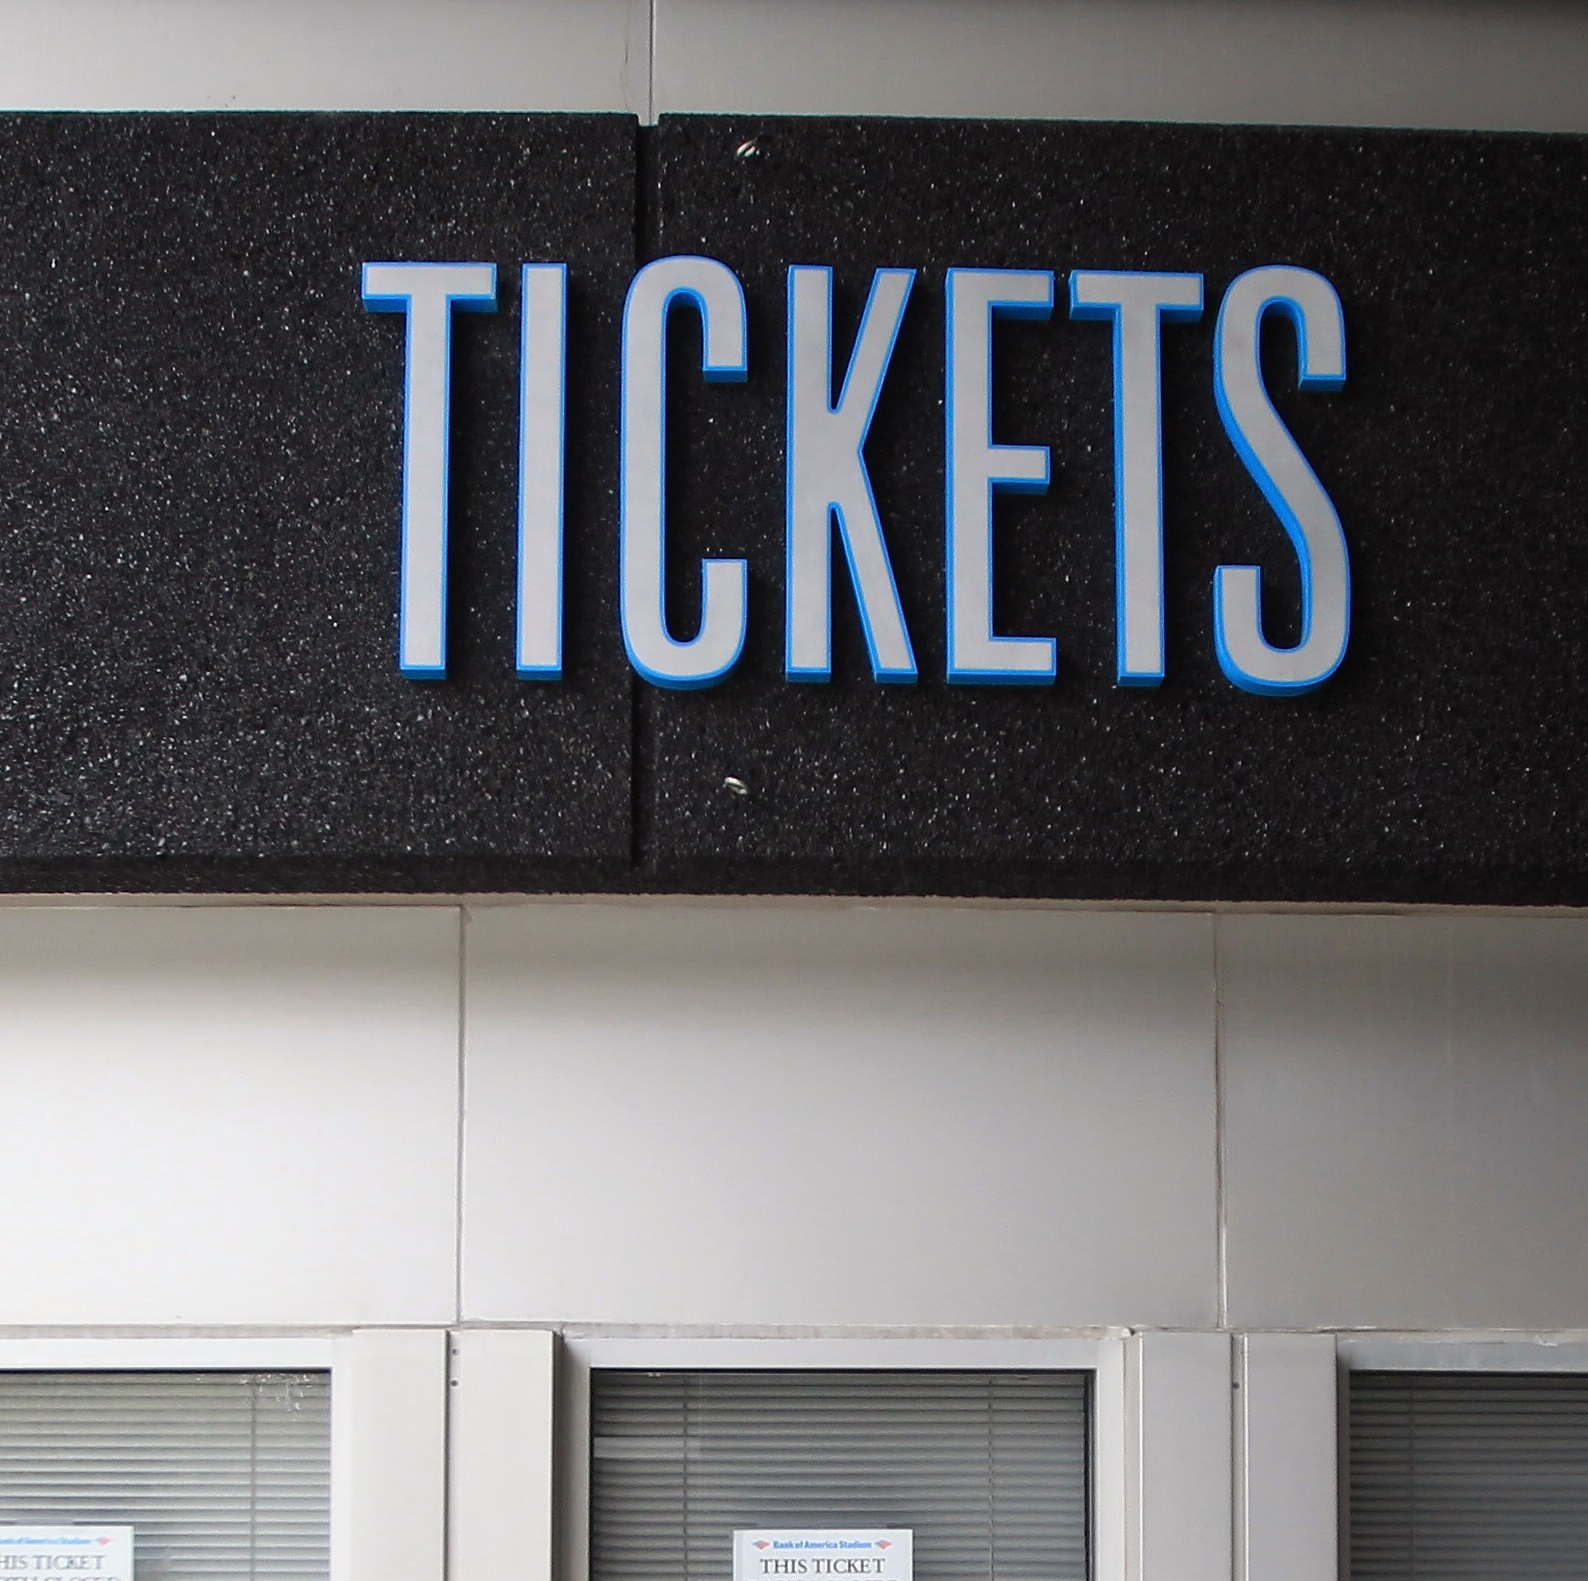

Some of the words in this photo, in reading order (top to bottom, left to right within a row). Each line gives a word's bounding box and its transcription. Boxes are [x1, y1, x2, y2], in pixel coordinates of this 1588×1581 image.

[361, 253, 1351, 697] TICKETS
[773, 1541, 794, 1549] Bank
[795, 1541, 803, 1549] of
[804, 1541, 838, 1549] America
[840, 1541, 872, 1549] Stadium
[33, 1555, 104, 1570] TICKET
[761, 1559, 807, 1573] THIS
[813, 1559, 884, 1573] TICKET
